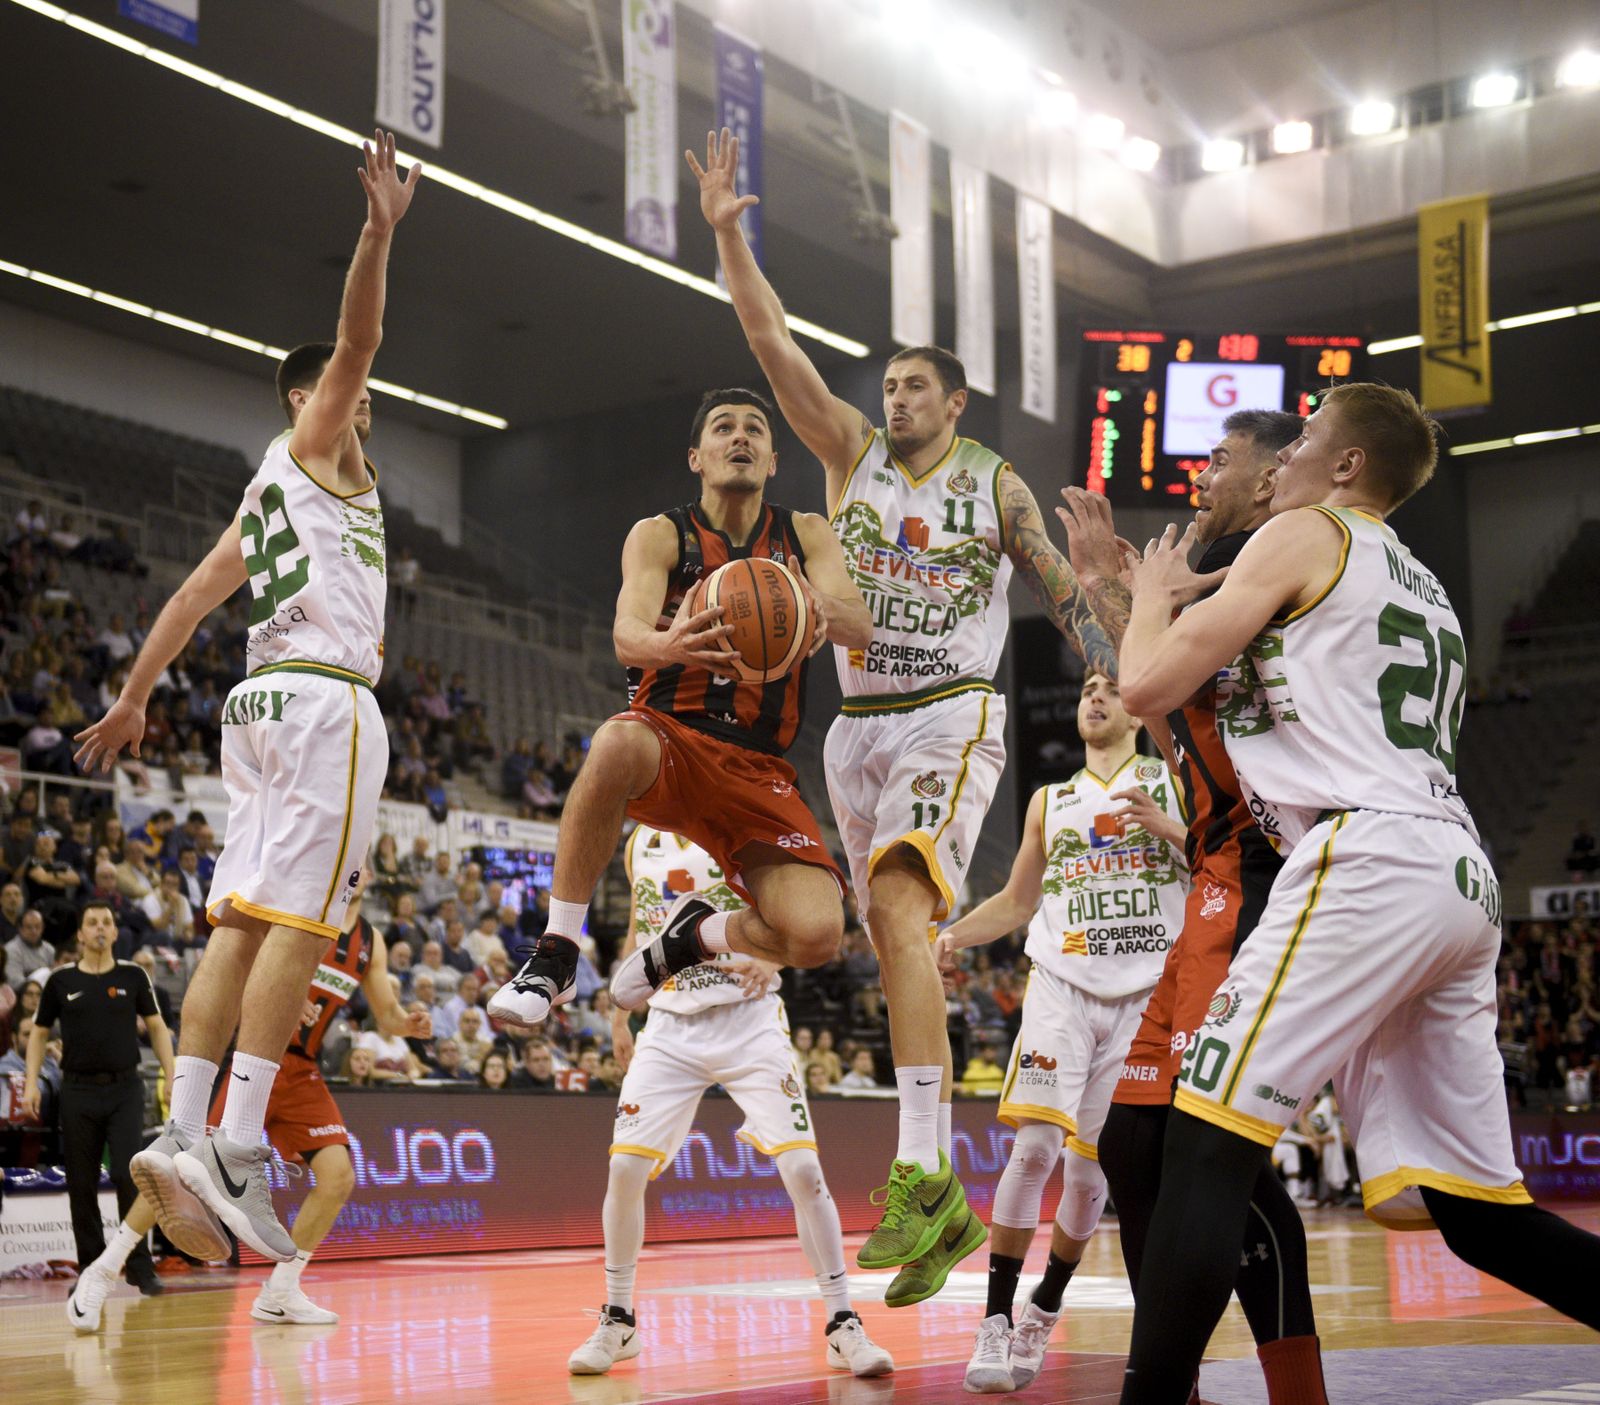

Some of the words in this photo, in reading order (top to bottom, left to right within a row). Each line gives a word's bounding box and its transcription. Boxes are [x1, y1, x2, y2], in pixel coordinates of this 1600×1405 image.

[1207, 374, 1238, 407] G
[942, 498, 976, 536] 11
[241, 483, 310, 628] 22
[762, 568, 788, 639] molten
[862, 591, 959, 637] UESCA
[867, 657, 887, 675] DE
[868, 641, 948, 663] GOBIERNO
[1378, 602, 1467, 776] 20
[1065, 847, 1158, 881] LEVITEC
[1068, 887, 1162, 925] HUESCA
[1086, 924, 1166, 942] GOBIERNO
[1088, 942, 1108, 956] DE
[1114, 938, 1173, 955] ARAGON
[1019, 1077, 1058, 1088] LCORAZ
[1273, 1089, 1301, 1110] barri
[791, 1103, 809, 1132] 3
